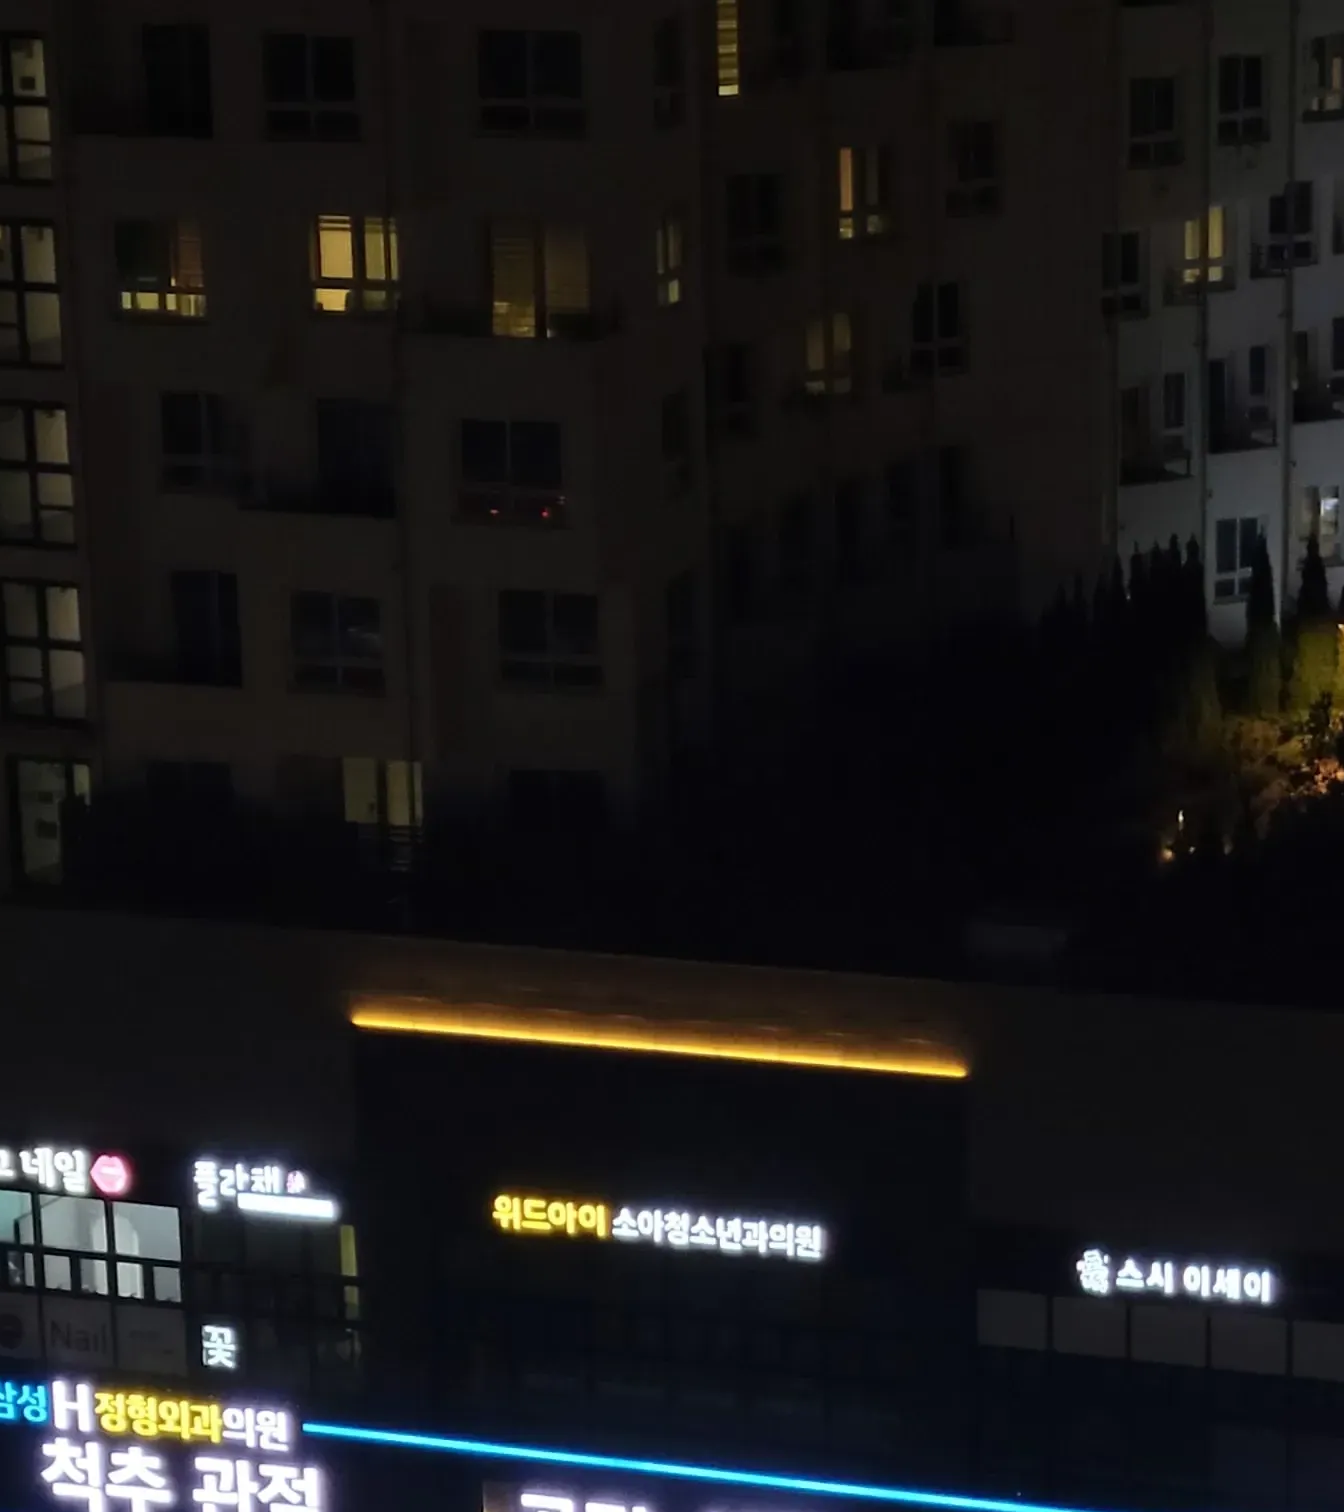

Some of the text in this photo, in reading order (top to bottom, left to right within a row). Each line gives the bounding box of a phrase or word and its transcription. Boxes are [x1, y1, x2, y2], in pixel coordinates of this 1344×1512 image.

[19, 1147, 89, 1194] 네일
[1116, 1258, 1273, 1304] 스시 이세이
[50, 1320, 107, 1354] Nail
[202, 1325, 237, 1369] 꽃
